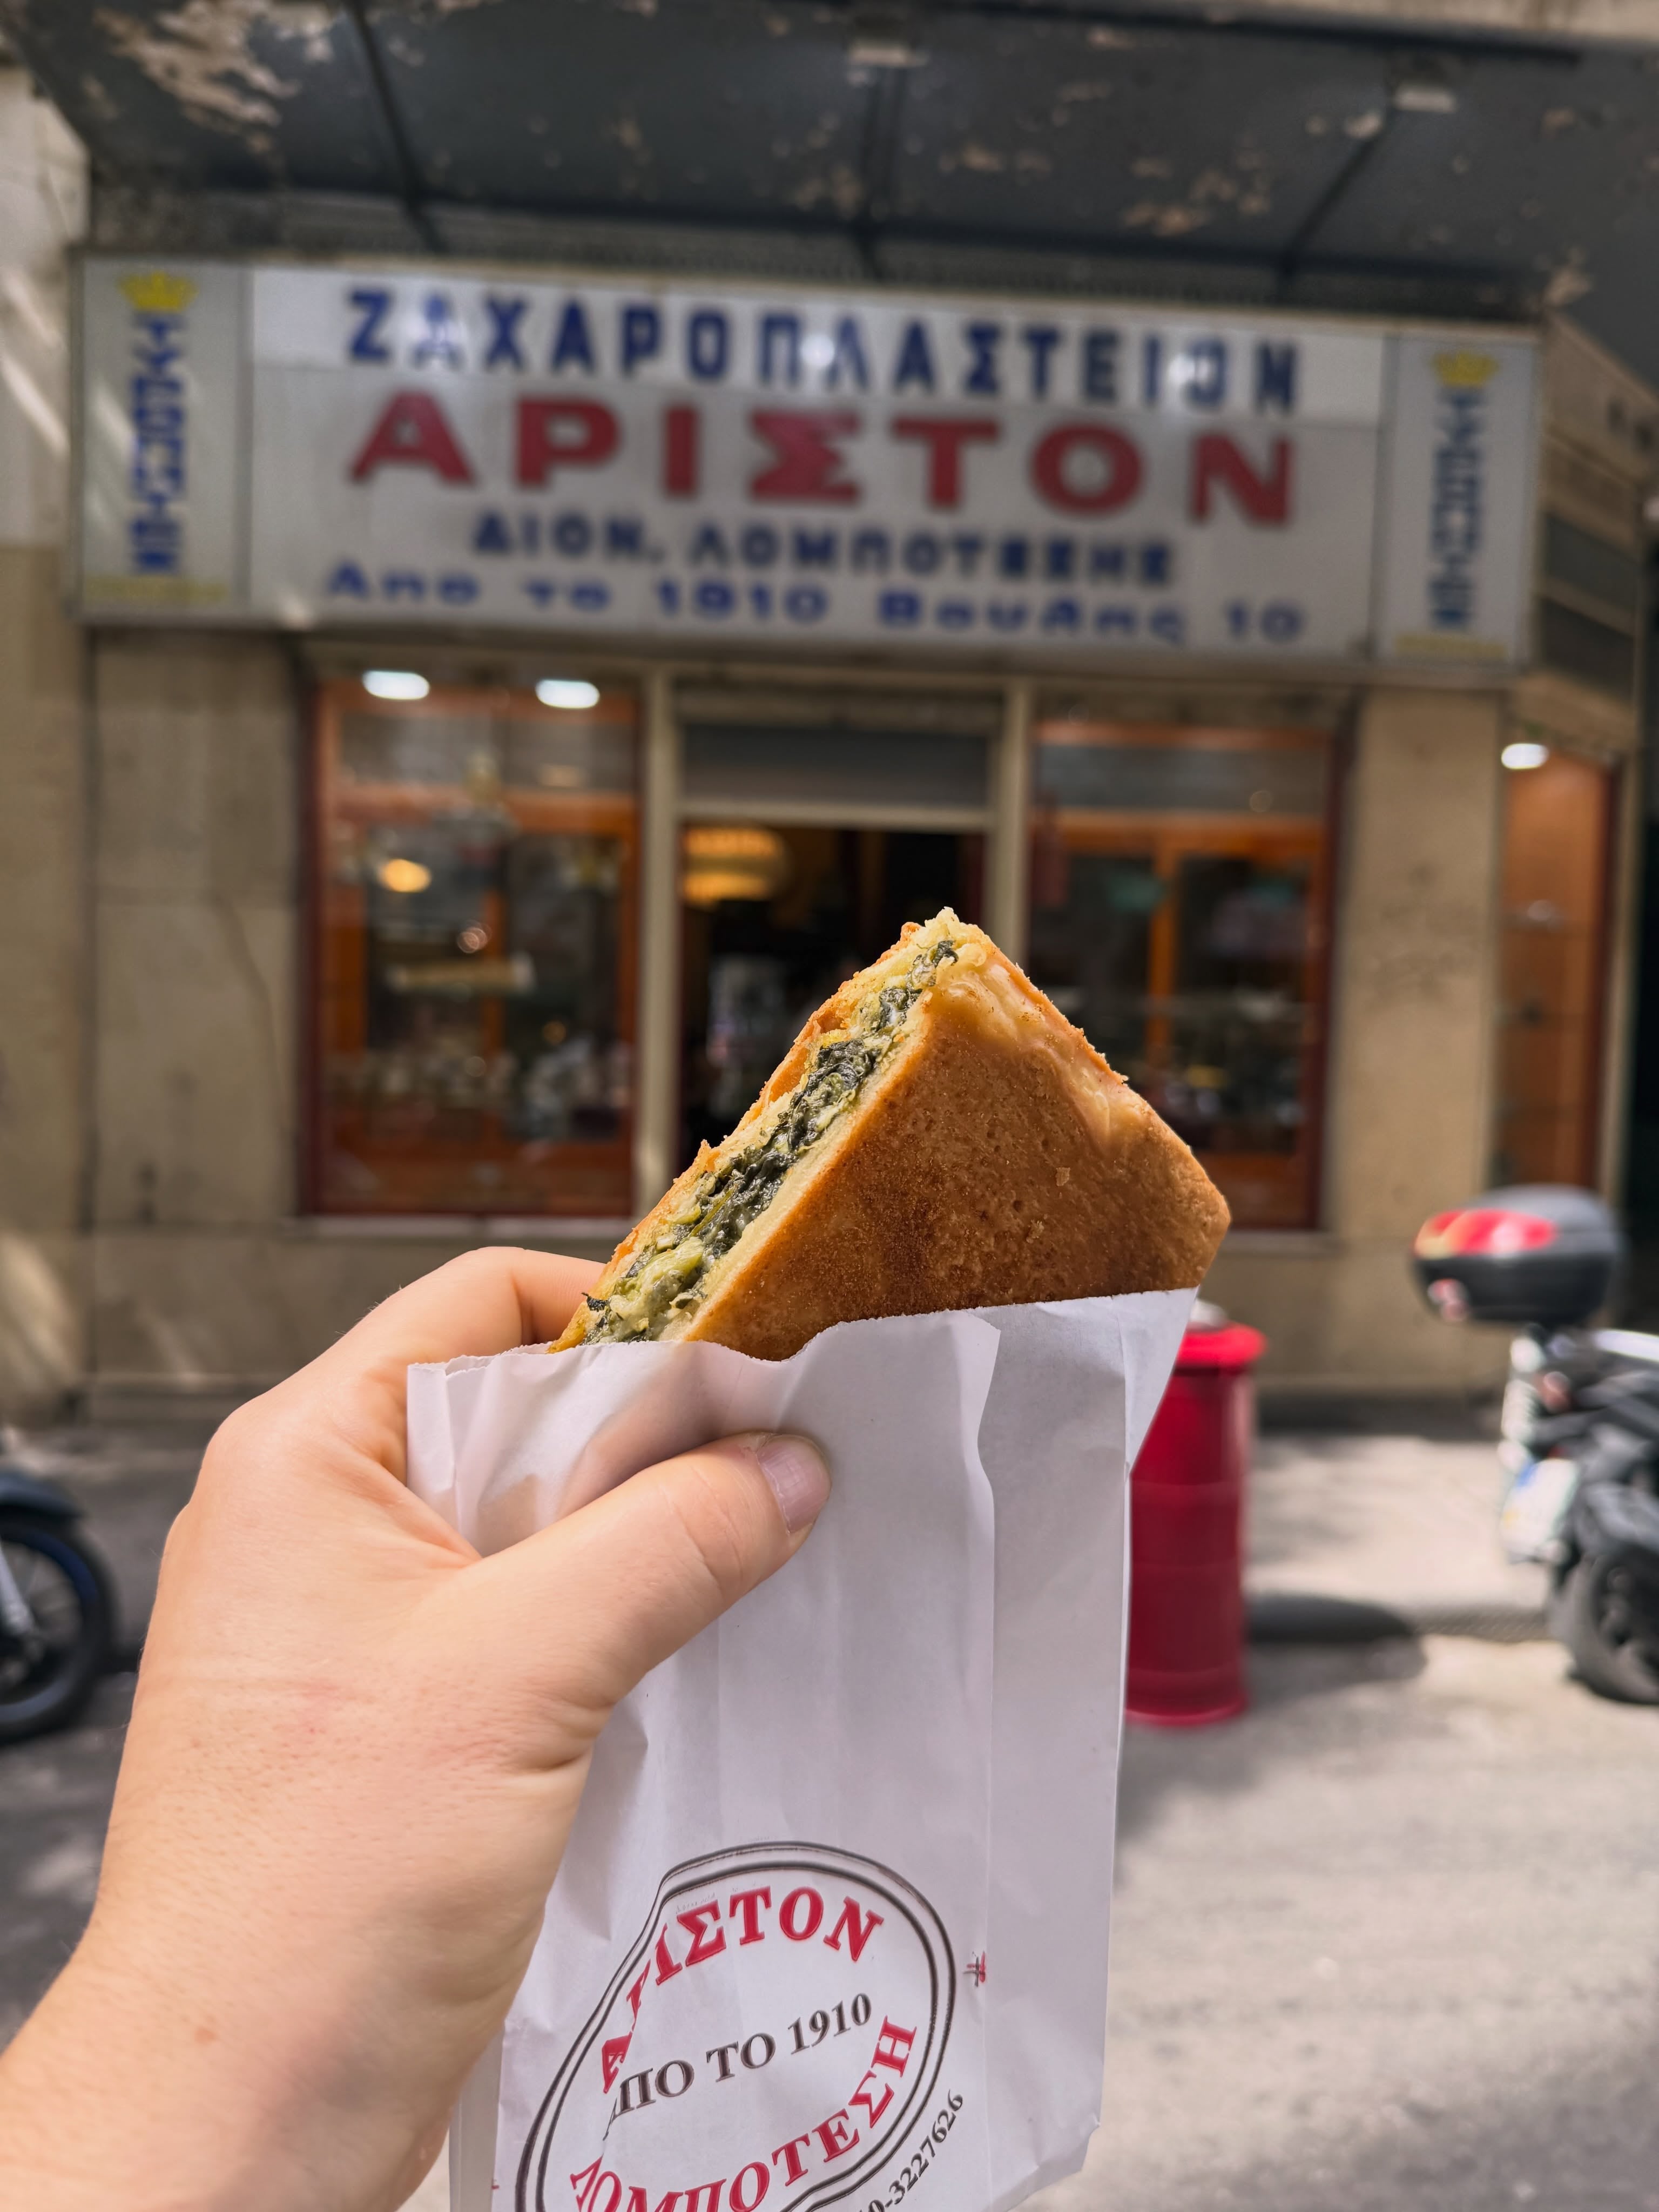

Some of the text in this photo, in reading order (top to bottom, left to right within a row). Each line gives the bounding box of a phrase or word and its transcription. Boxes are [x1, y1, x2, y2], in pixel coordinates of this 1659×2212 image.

[348, 287, 1300, 413] ΖΑΧΑΡΟΠΛΑΣΤΕΙΟΝ
[347, 390, 1292, 527] ΑΡΙΣΤΟΝ
[473, 511, 664, 563] ΔΙΟΝ.
[656, 580, 829, 623] 1910
[1225, 597, 1303, 642] 10
[603, 1993, 872, 2140] ΠΟ ΤΟ 1910
[859, 2088, 963, 2212] 0-3227626
